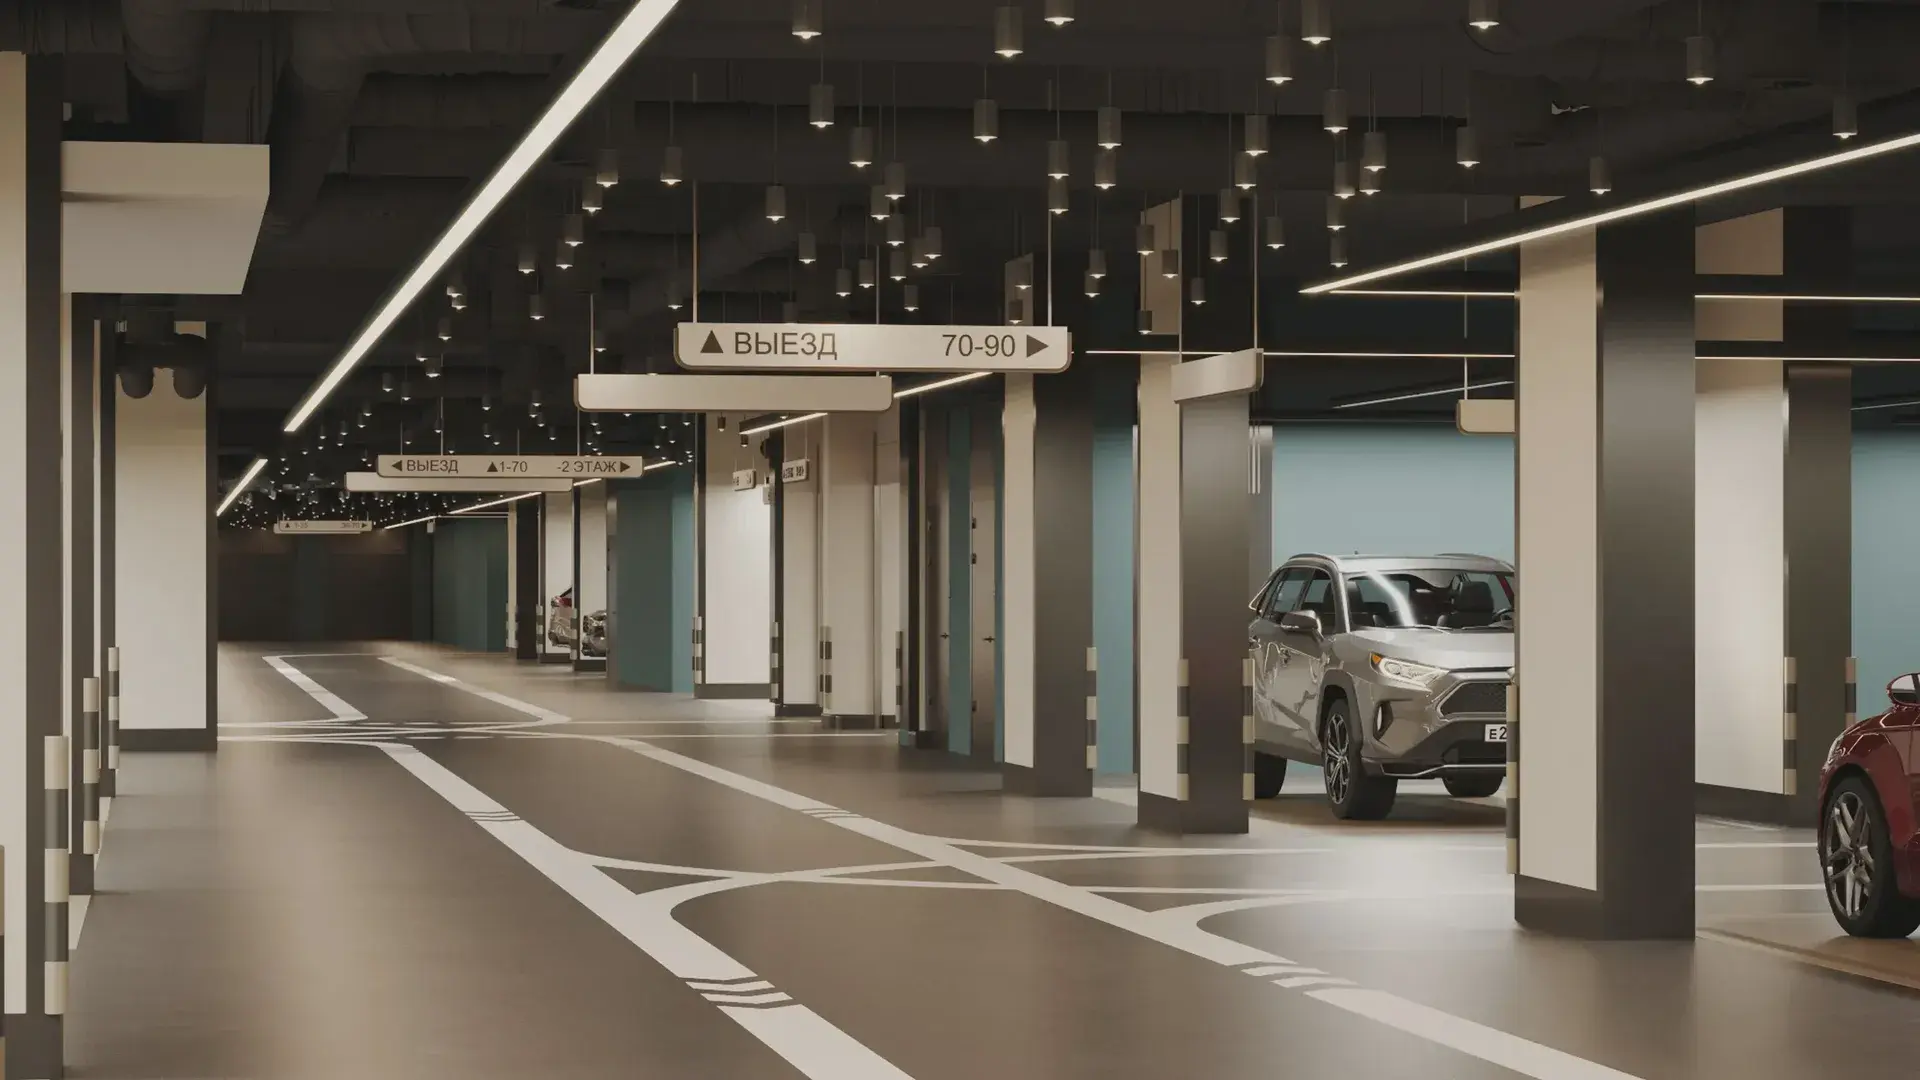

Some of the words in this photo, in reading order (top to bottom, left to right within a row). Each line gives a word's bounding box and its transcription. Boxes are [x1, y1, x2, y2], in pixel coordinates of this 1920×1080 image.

[734, 331, 838, 361] ВЫЕЗД
[942, 334, 1016, 358] 70-90
[406, 459, 459, 474] ВЫЕЗД
[499, 460, 528, 473] 1-70
[557, 460, 570, 473] -2
[573, 460, 617, 473] ЭТАЖ
